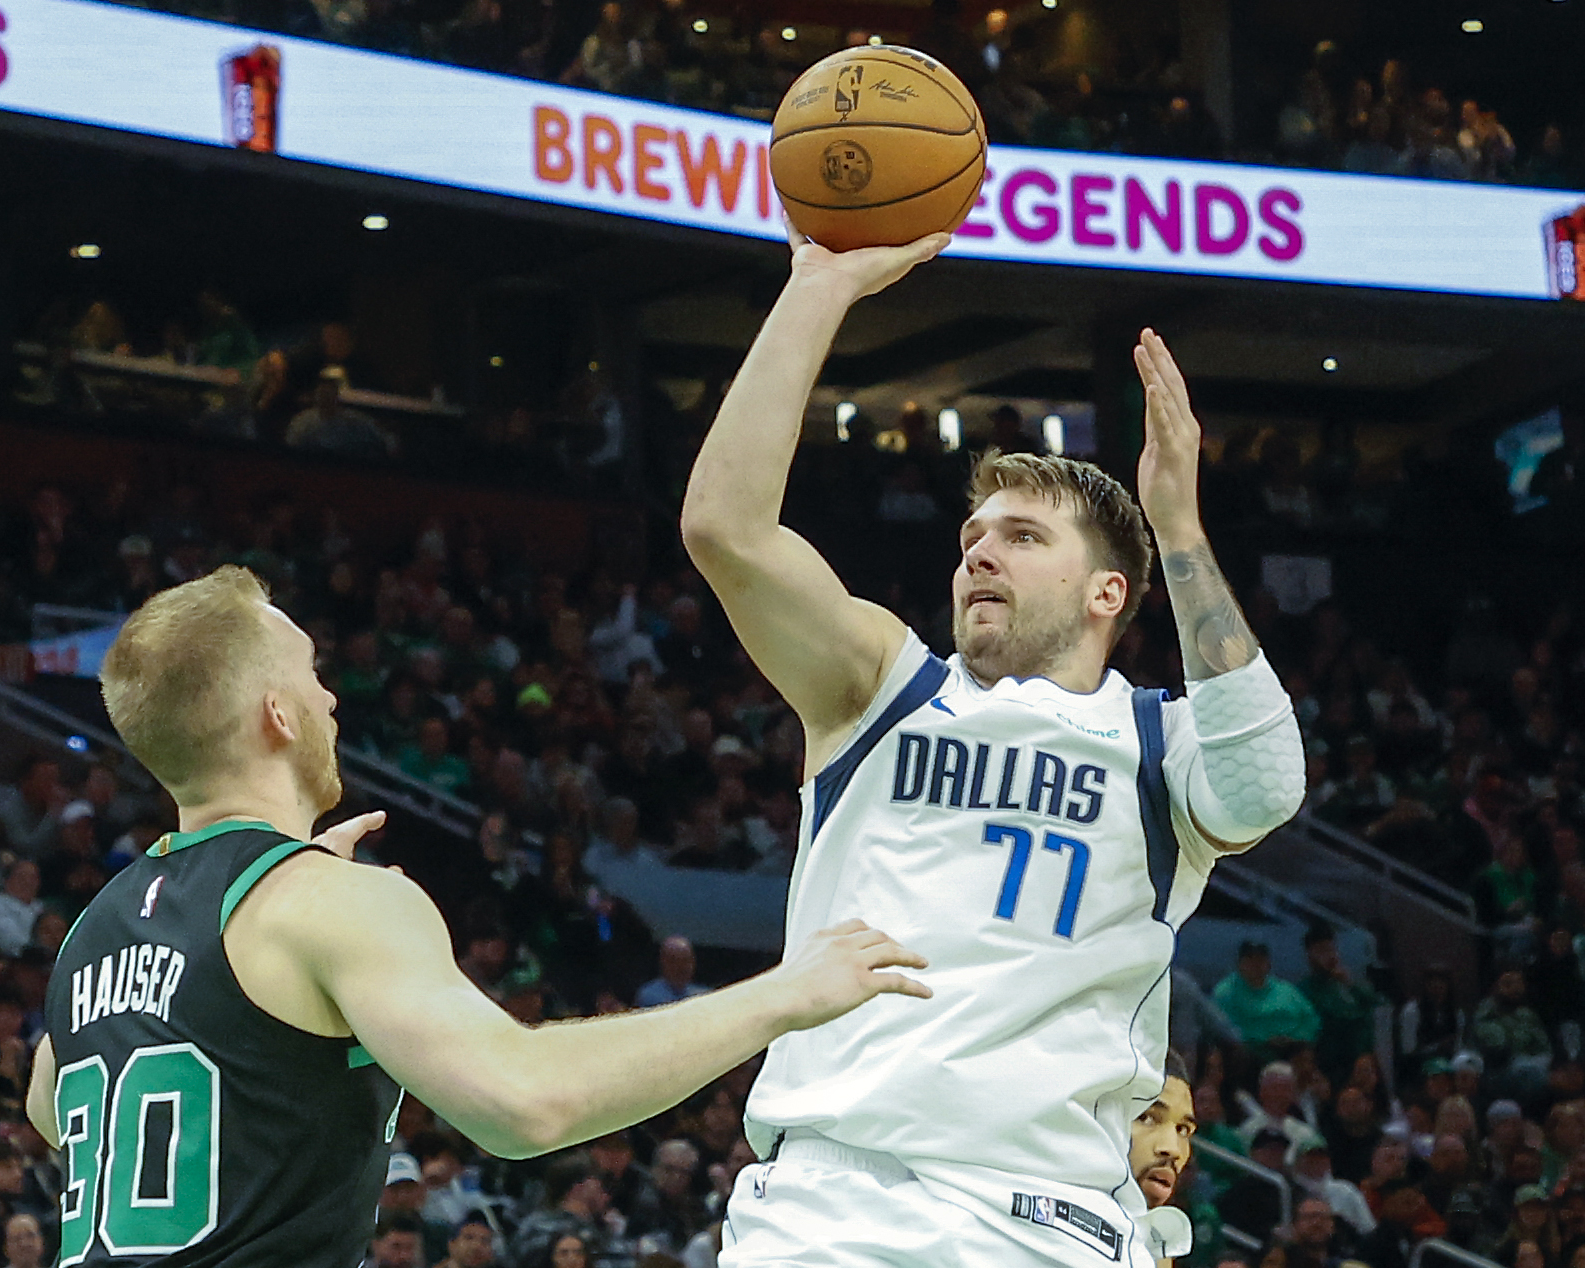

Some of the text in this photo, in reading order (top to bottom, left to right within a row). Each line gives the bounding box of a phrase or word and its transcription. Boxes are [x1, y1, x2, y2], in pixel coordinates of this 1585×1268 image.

[533, 105, 784, 219] BREWI
[890, 731, 1108, 827] DALLAS
[981, 820, 1093, 942] 77
[70, 943, 187, 1035] HAUSER
